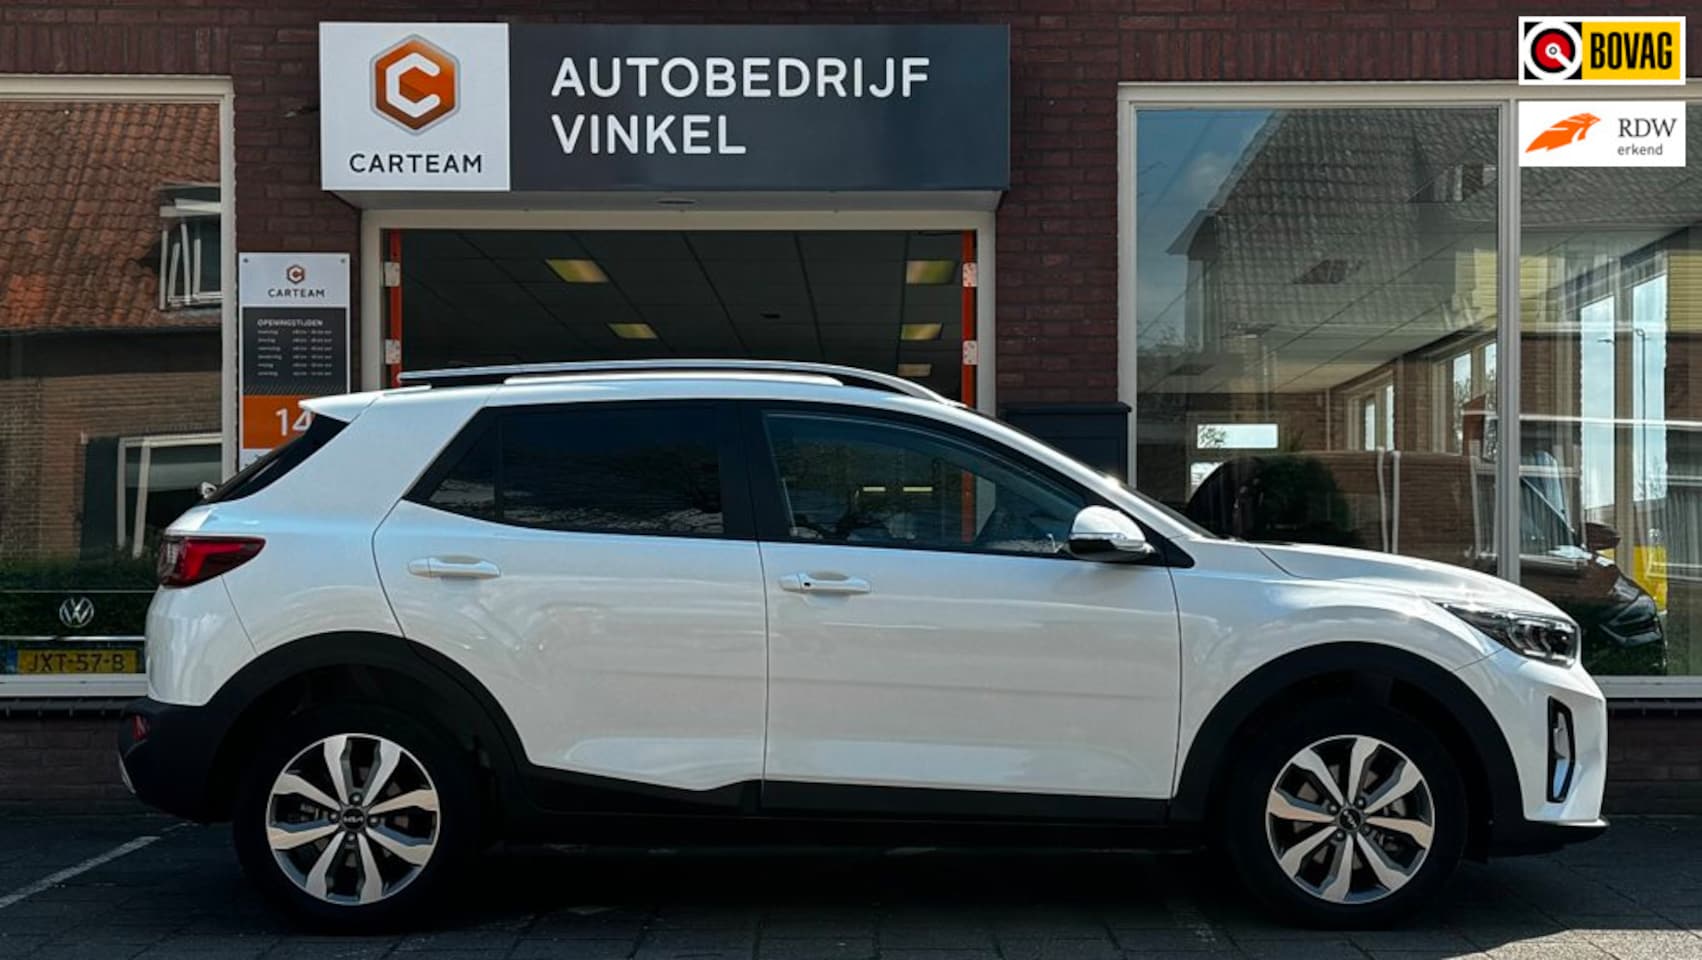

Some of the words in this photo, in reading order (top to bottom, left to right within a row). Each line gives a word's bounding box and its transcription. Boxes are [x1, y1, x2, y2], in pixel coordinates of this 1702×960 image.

[551, 57, 930, 98] AUTOBEDRIJF
[551, 114, 747, 155] VINKEL
[349, 153, 483, 173] CARTEAM
[267, 288, 326, 299] CARTEAM
[28, 652, 126, 673] JXT-57-B
